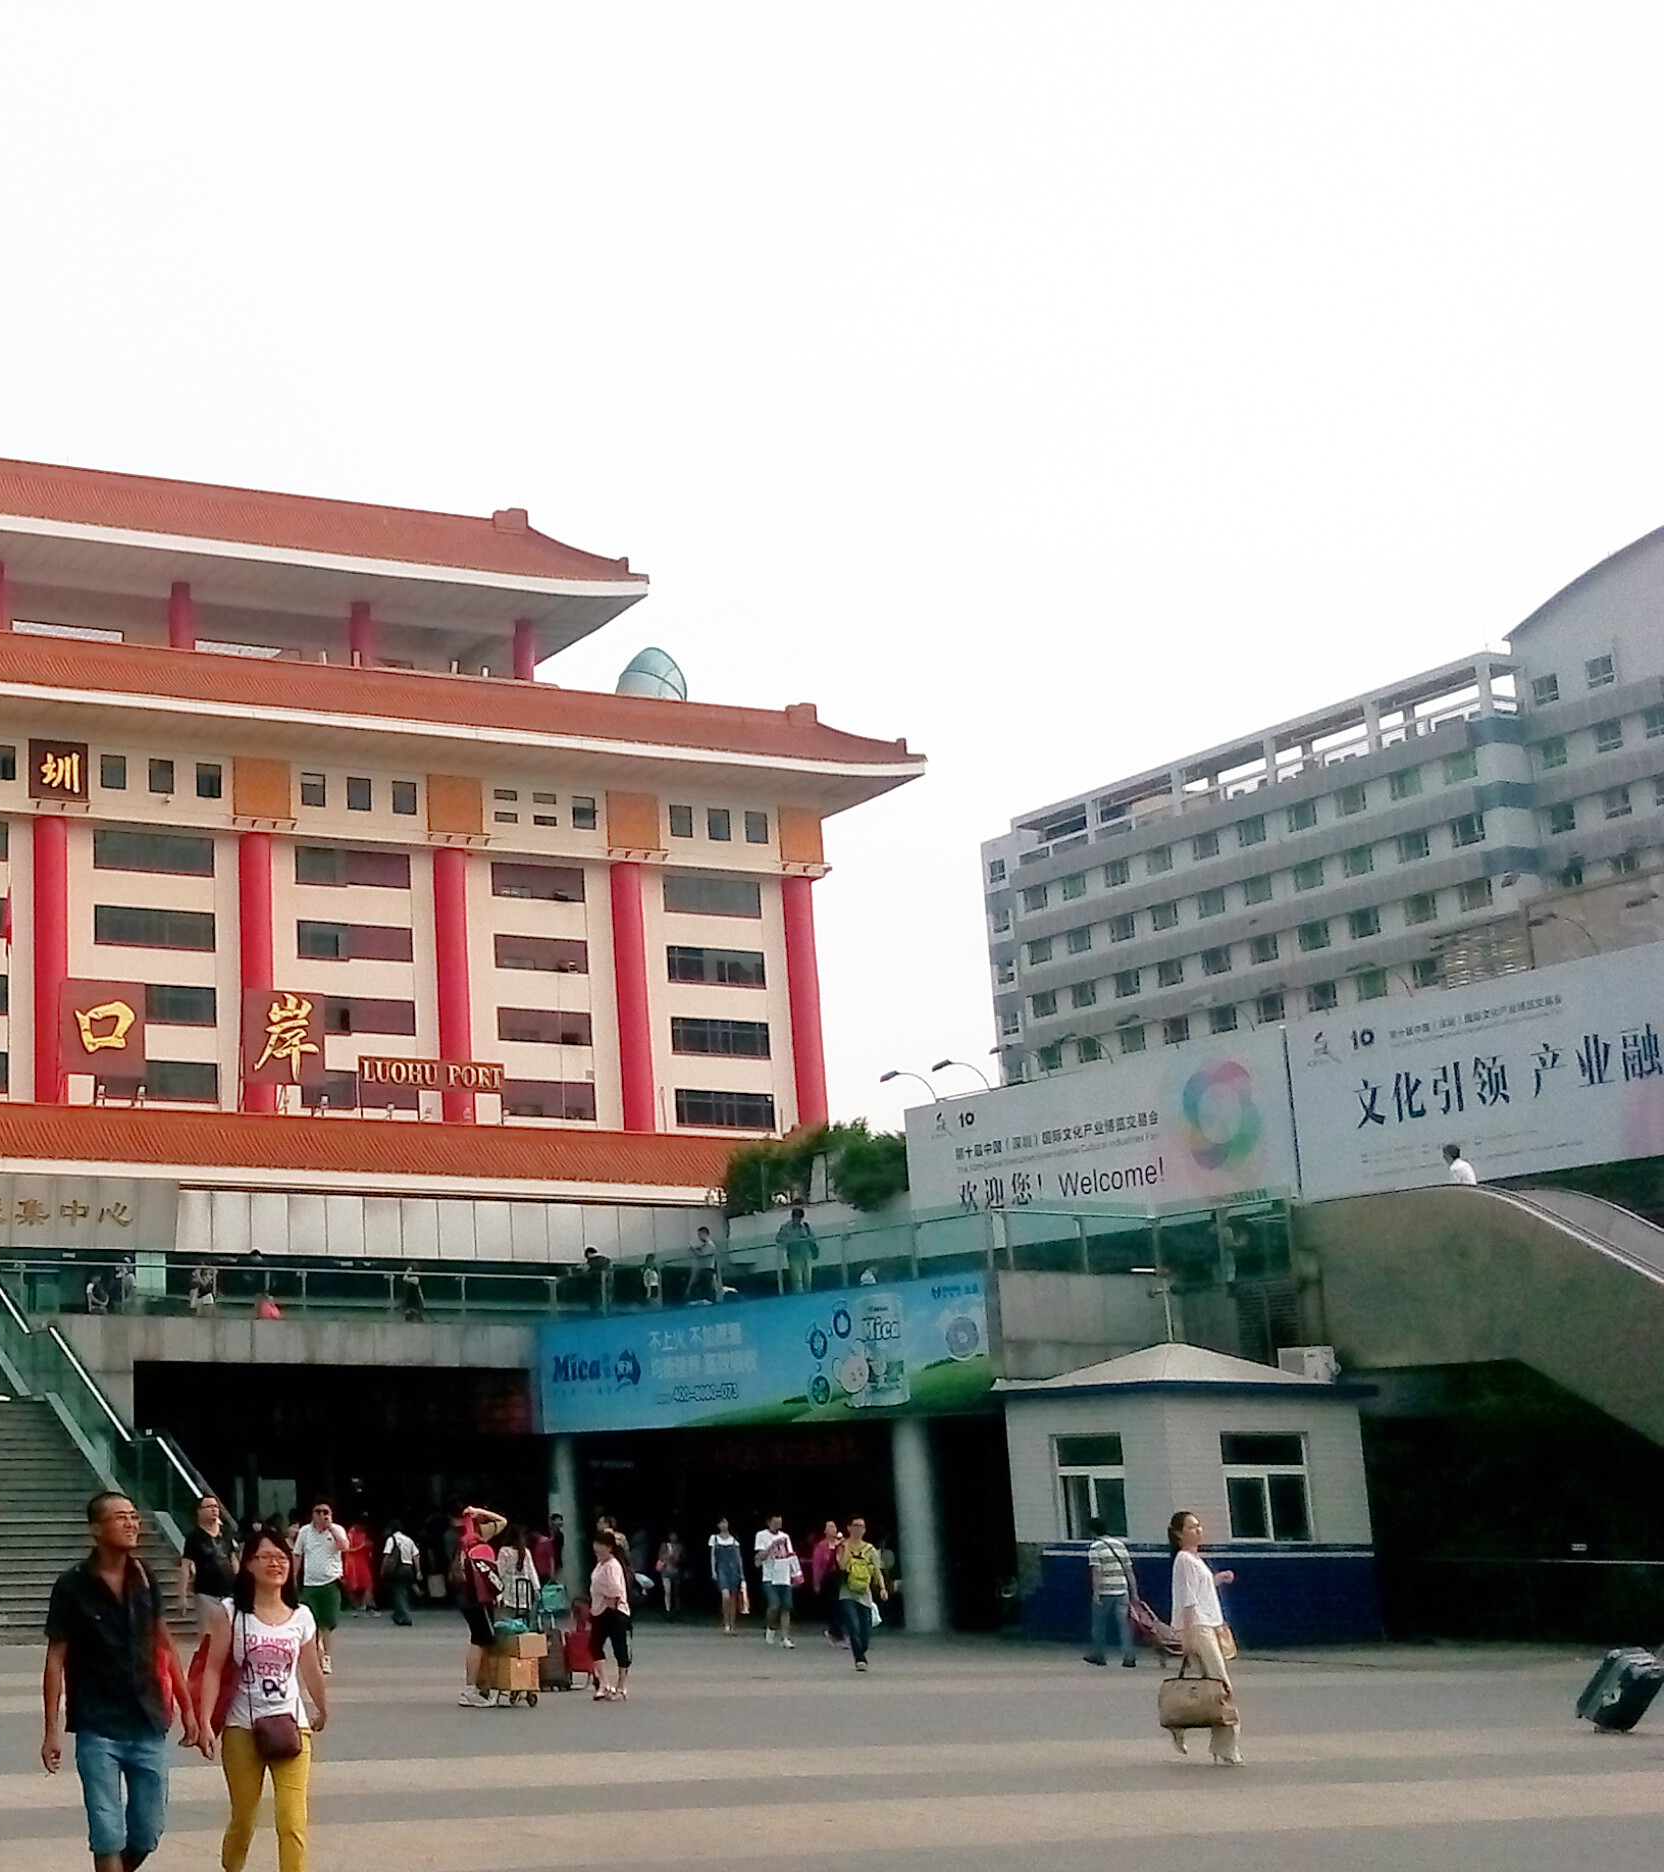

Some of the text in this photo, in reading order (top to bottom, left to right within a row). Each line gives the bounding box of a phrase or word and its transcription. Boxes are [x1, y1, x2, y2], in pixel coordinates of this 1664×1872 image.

[1351, 1027, 1375, 1051] 10
[362, 1060, 503, 1089] LUOHU PORT
[1352, 1053, 1511, 1130] 文化引领
[1529, 1022, 1664, 1099] 产业融
[959, 1111, 976, 1129] 10
[1058, 1156, 1165, 1198] Welcome!
[552, 1353, 601, 1384] Mica
